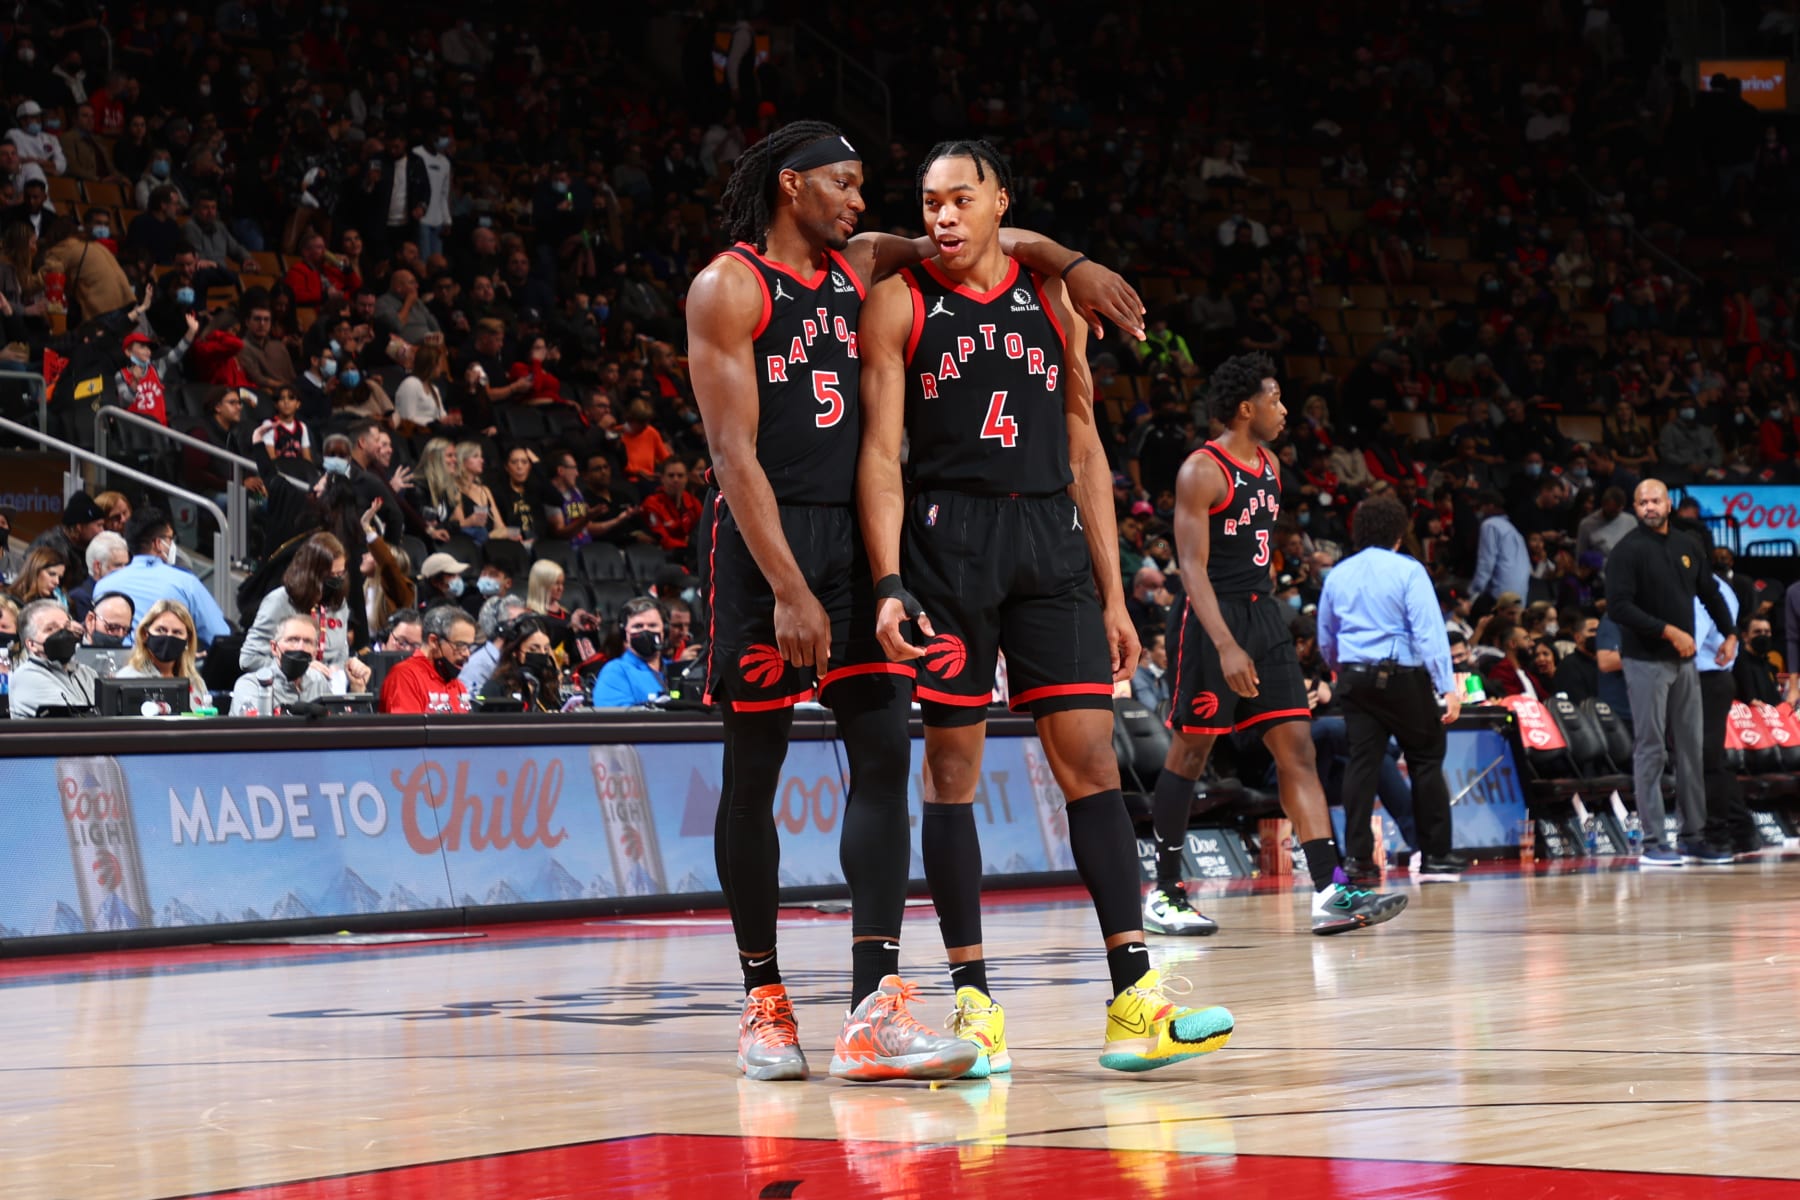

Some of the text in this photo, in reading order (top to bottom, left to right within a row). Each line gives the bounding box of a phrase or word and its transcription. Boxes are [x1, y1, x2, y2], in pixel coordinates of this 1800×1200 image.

[1010, 304, 1025, 312] Sun
[767, 307, 859, 383] RAPTOR
[920, 323, 1059, 400] RAPTORS
[812, 369, 845, 428] 5
[980, 391, 1018, 448] 4
[1224, 489, 1280, 535] RAPTO
[1722, 491, 1800, 529] Coor
[1253, 529, 1270, 566] 3
[60, 777, 125, 821] Coor
[592, 762, 645, 801] Coor
[168, 758, 565, 855] MADE TO Chill
